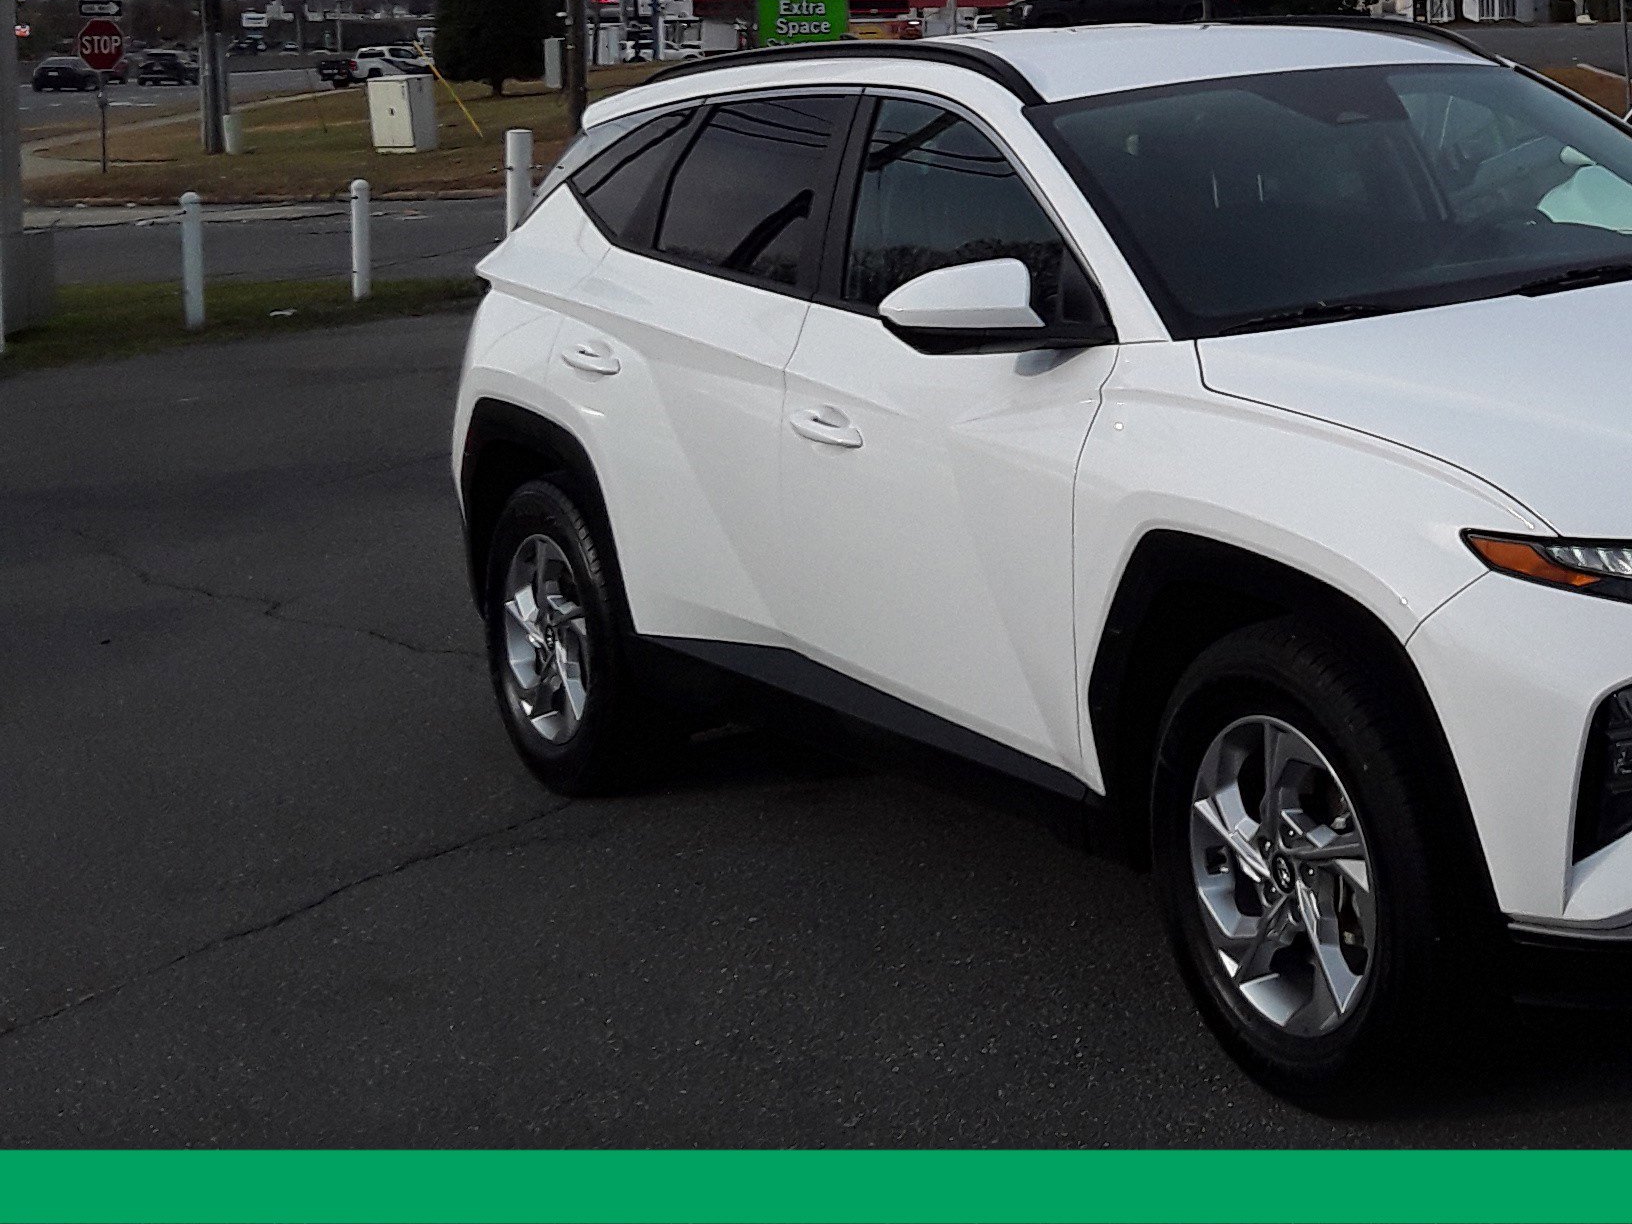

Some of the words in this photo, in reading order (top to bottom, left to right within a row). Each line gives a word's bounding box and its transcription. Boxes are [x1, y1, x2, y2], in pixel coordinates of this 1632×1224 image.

[780, 0, 826, 15] Extra
[776, 18, 831, 37] Space
[82, 36, 121, 54] STOP
